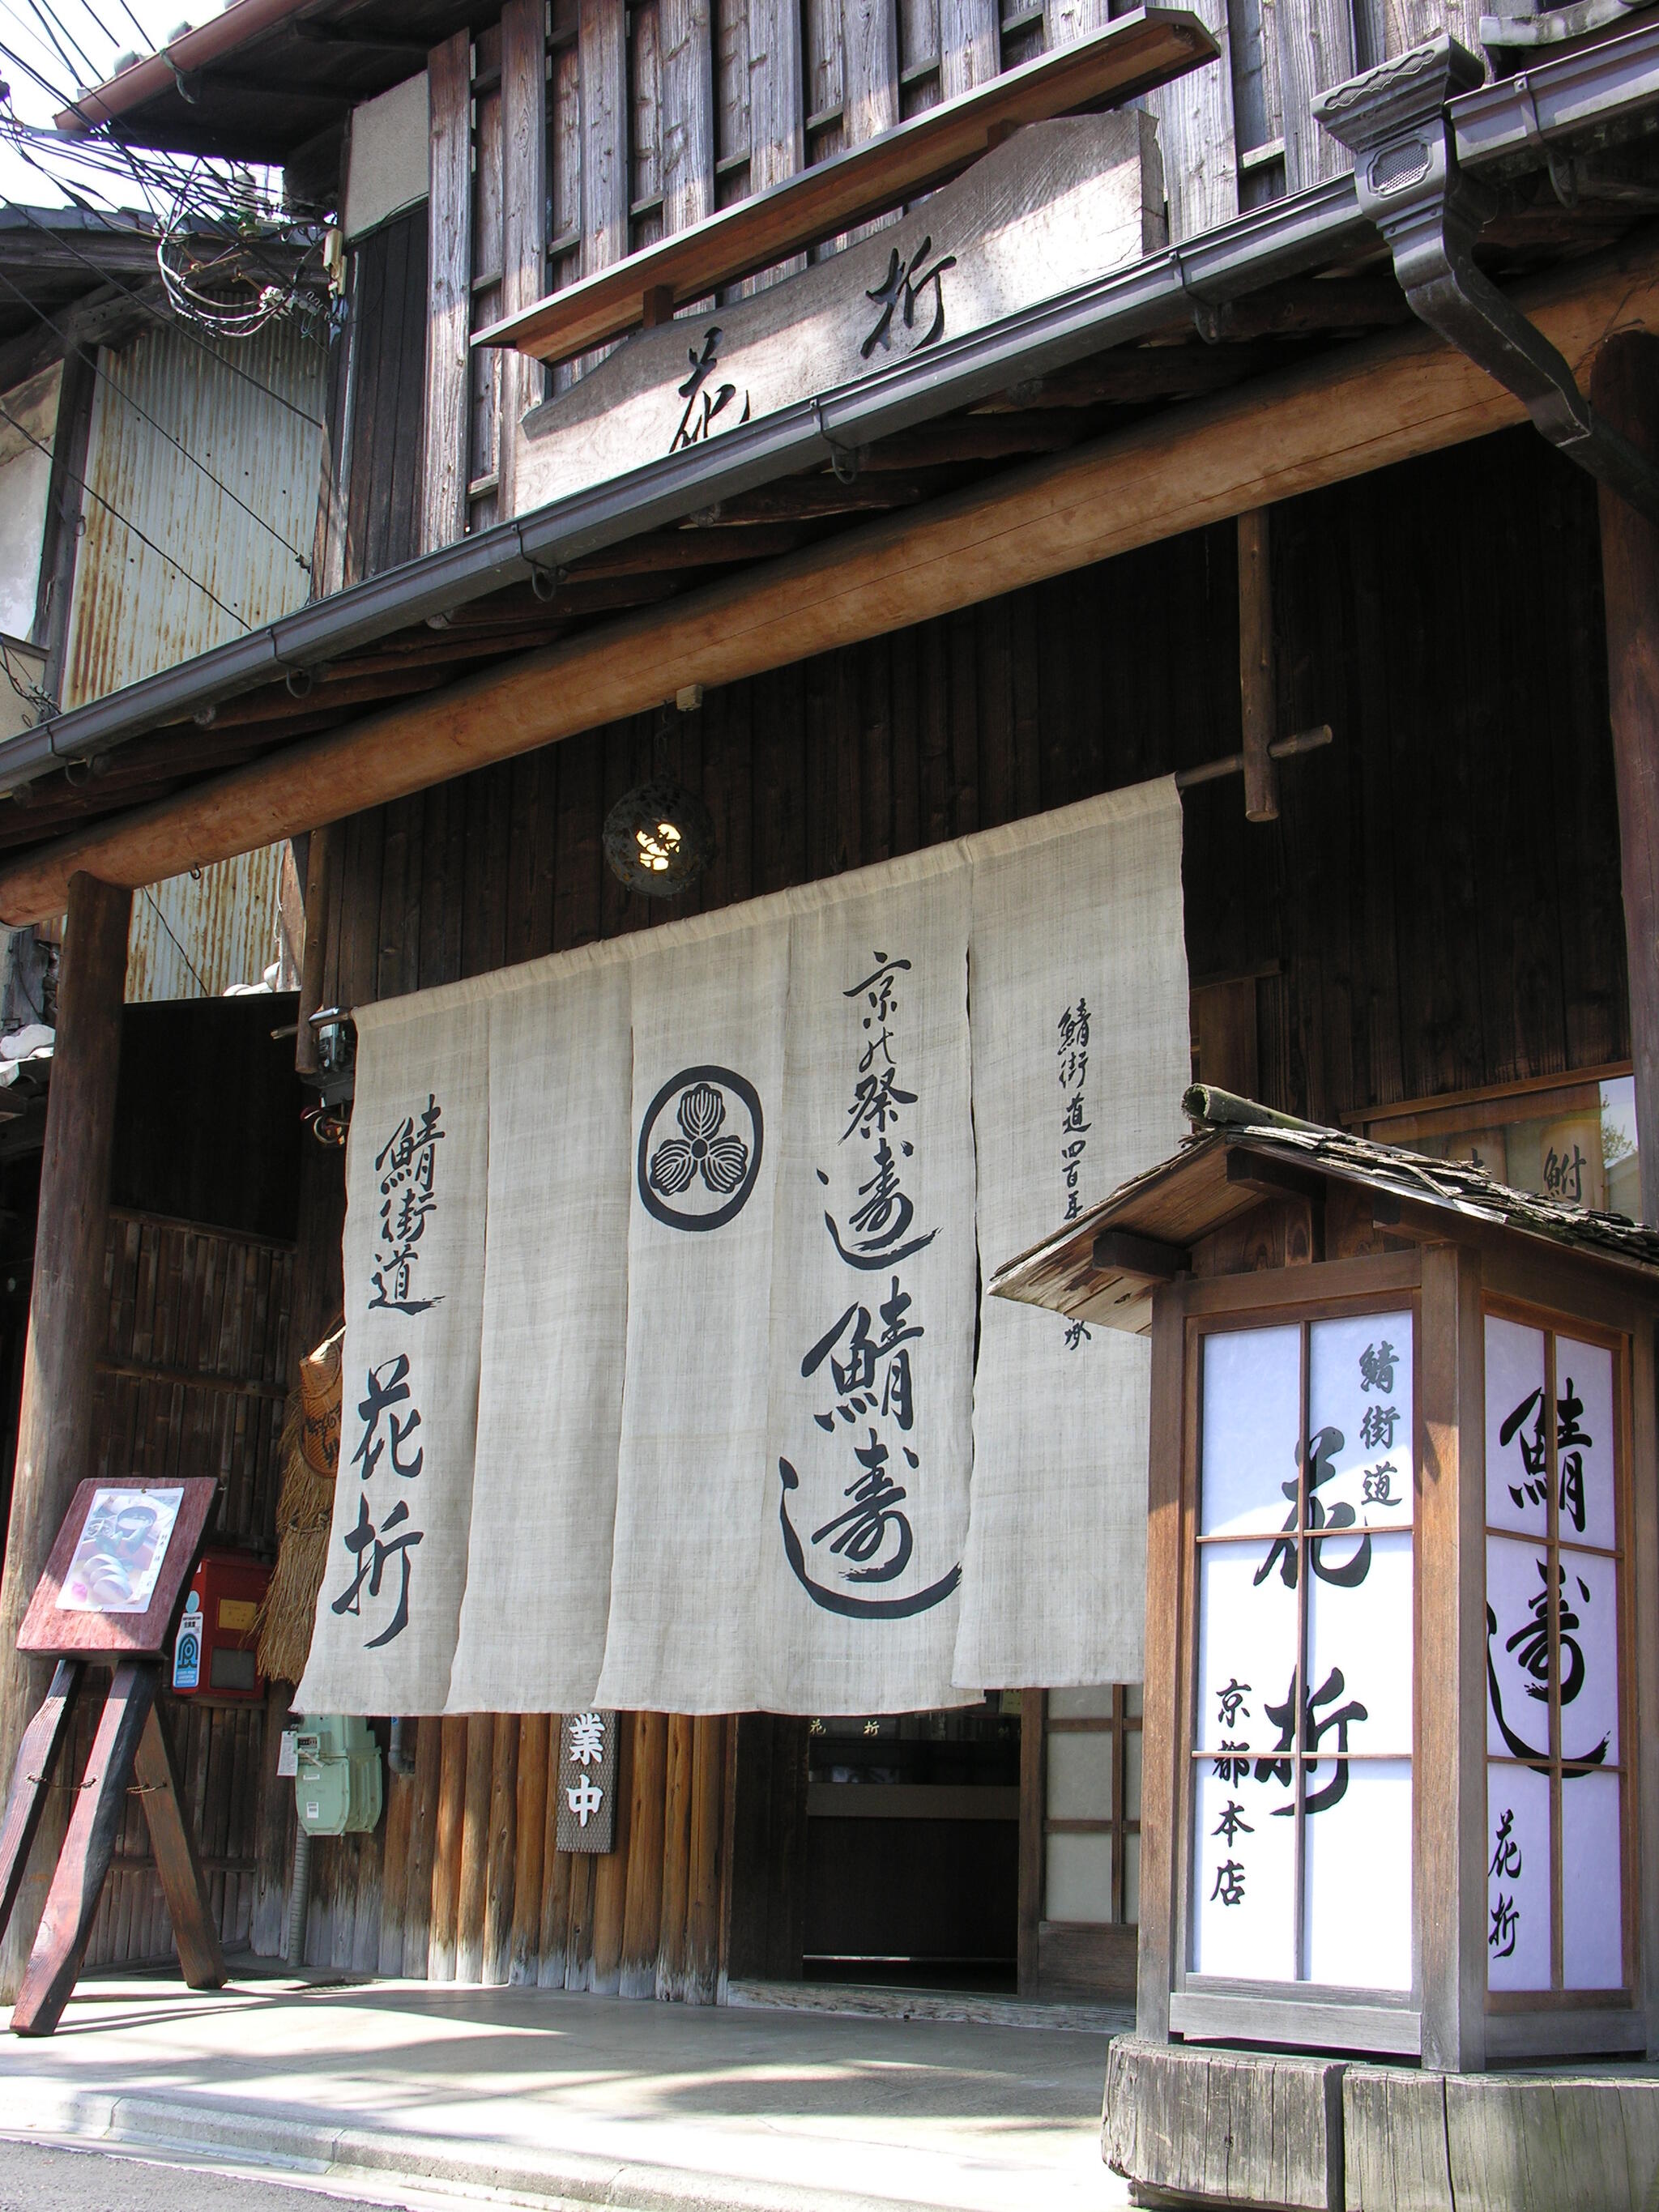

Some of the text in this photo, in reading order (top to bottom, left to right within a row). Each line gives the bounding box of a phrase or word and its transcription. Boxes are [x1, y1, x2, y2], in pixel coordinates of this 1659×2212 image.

[668, 236, 957, 454] 花折
[368, 1094, 445, 1315] 鯖街道
[331, 1353, 424, 1648] 花折
[1359, 1342, 1403, 1507] 鯖街道
[809, 1719, 881, 1736] 花折
[1254, 1426, 1371, 1817] 花折
[1211, 1679, 1256, 1906] 京都本店
[1489, 1809, 1521, 1958] 花折
